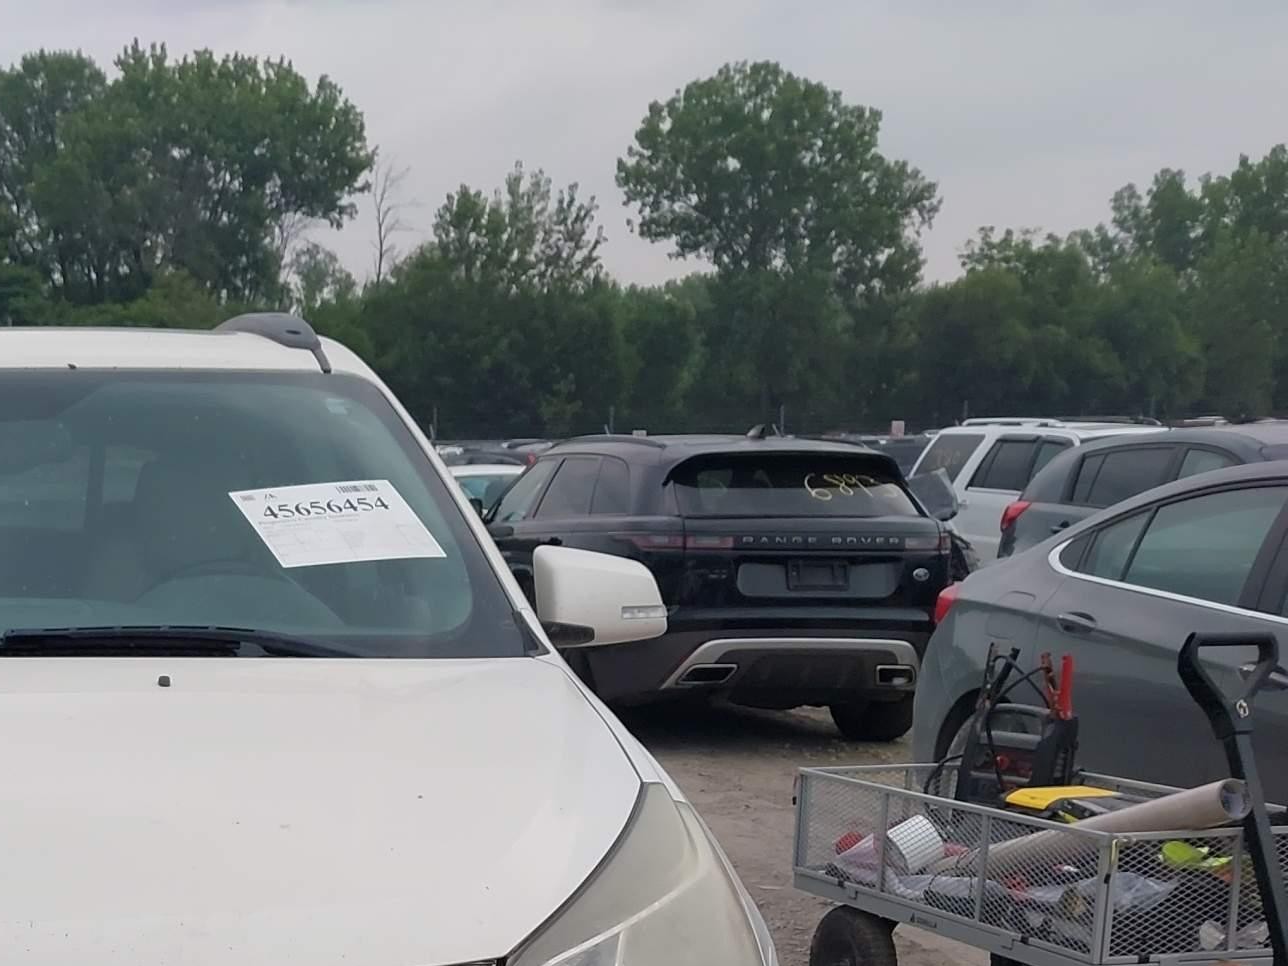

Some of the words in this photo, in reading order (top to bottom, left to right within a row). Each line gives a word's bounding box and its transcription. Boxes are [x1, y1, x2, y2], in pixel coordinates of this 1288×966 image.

[263, 496, 389, 519] 45656454
[742, 535, 818, 545] RANGE
[831, 535, 900, 545] ROVER
